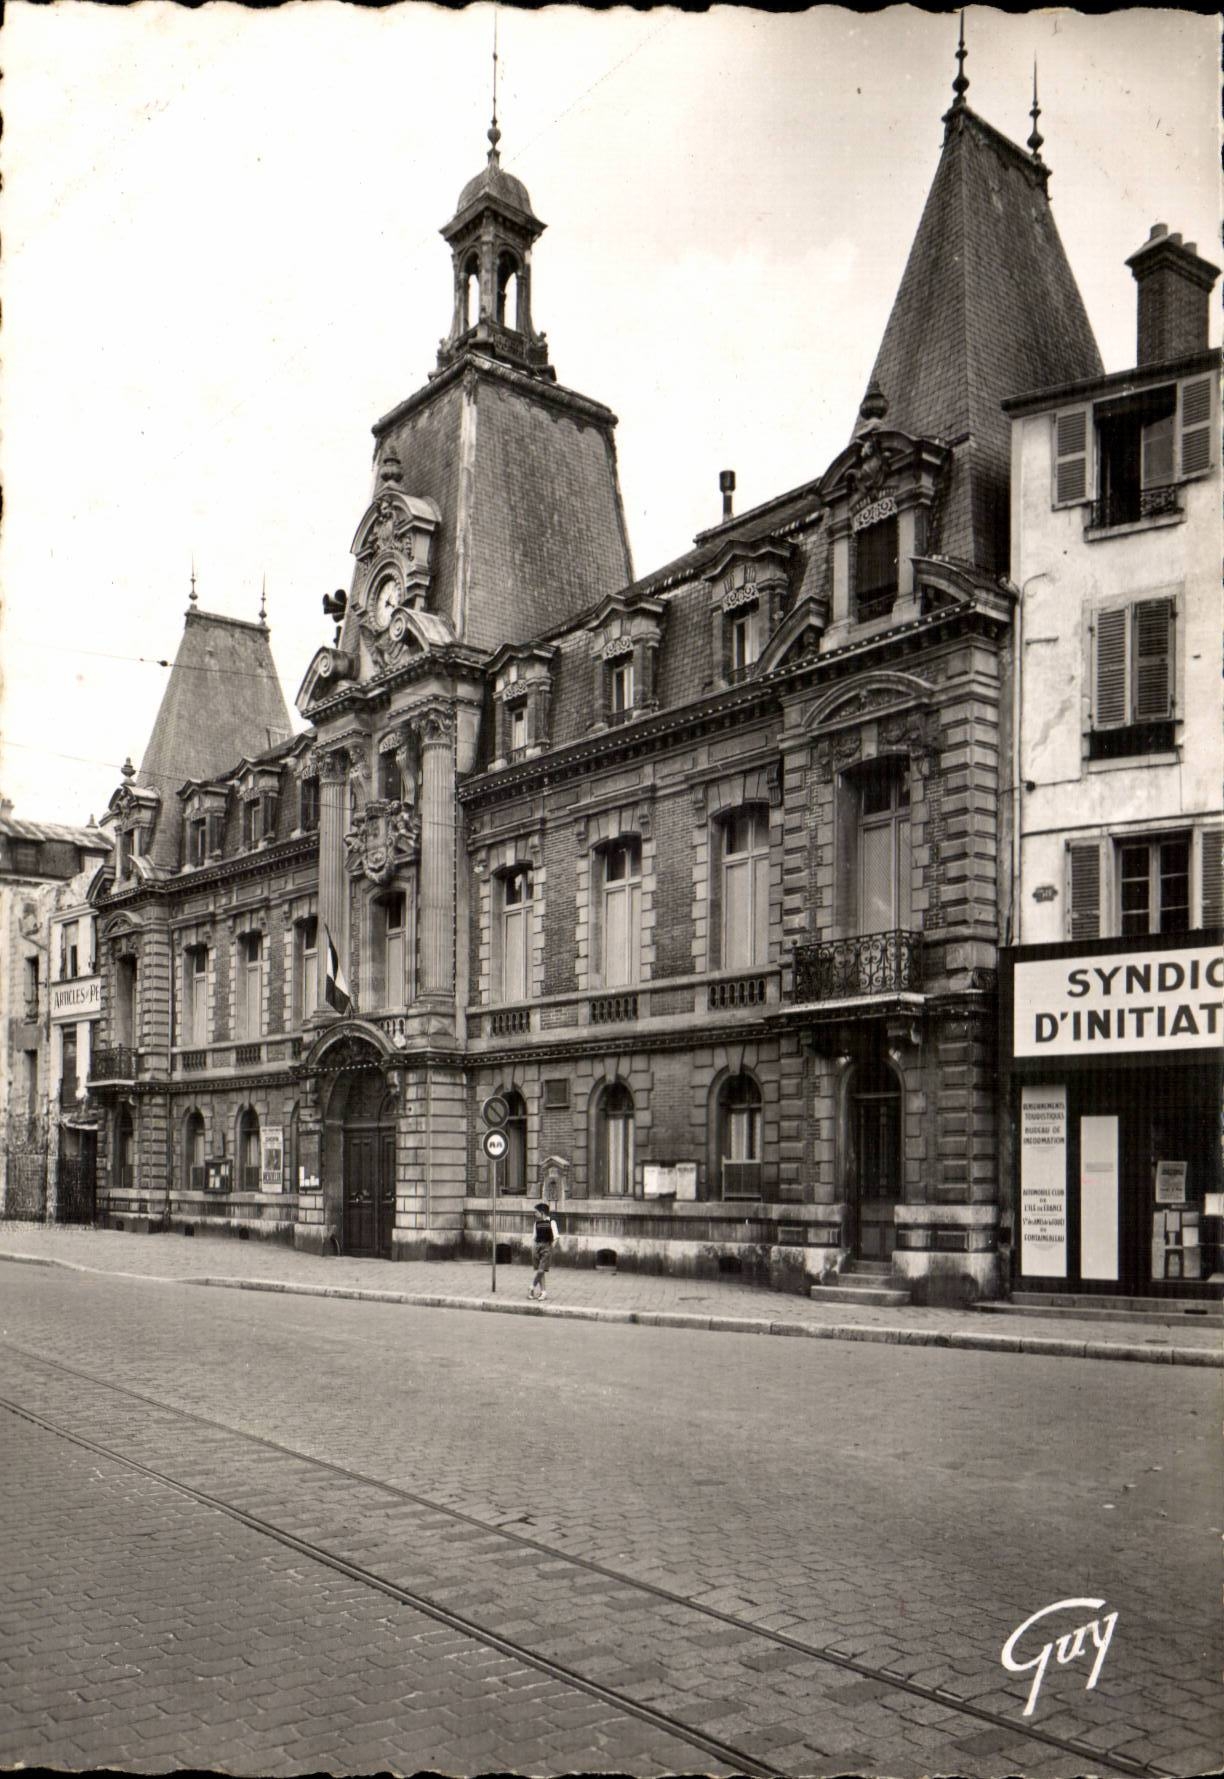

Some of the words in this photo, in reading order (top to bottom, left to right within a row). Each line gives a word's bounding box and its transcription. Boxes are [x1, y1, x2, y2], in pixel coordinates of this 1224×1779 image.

[54, 987, 86, 1010] ARTICLES
[1035, 1002, 1223, 1043] D'INITIAT
[1025, 1126, 1050, 1134] BUREAU
